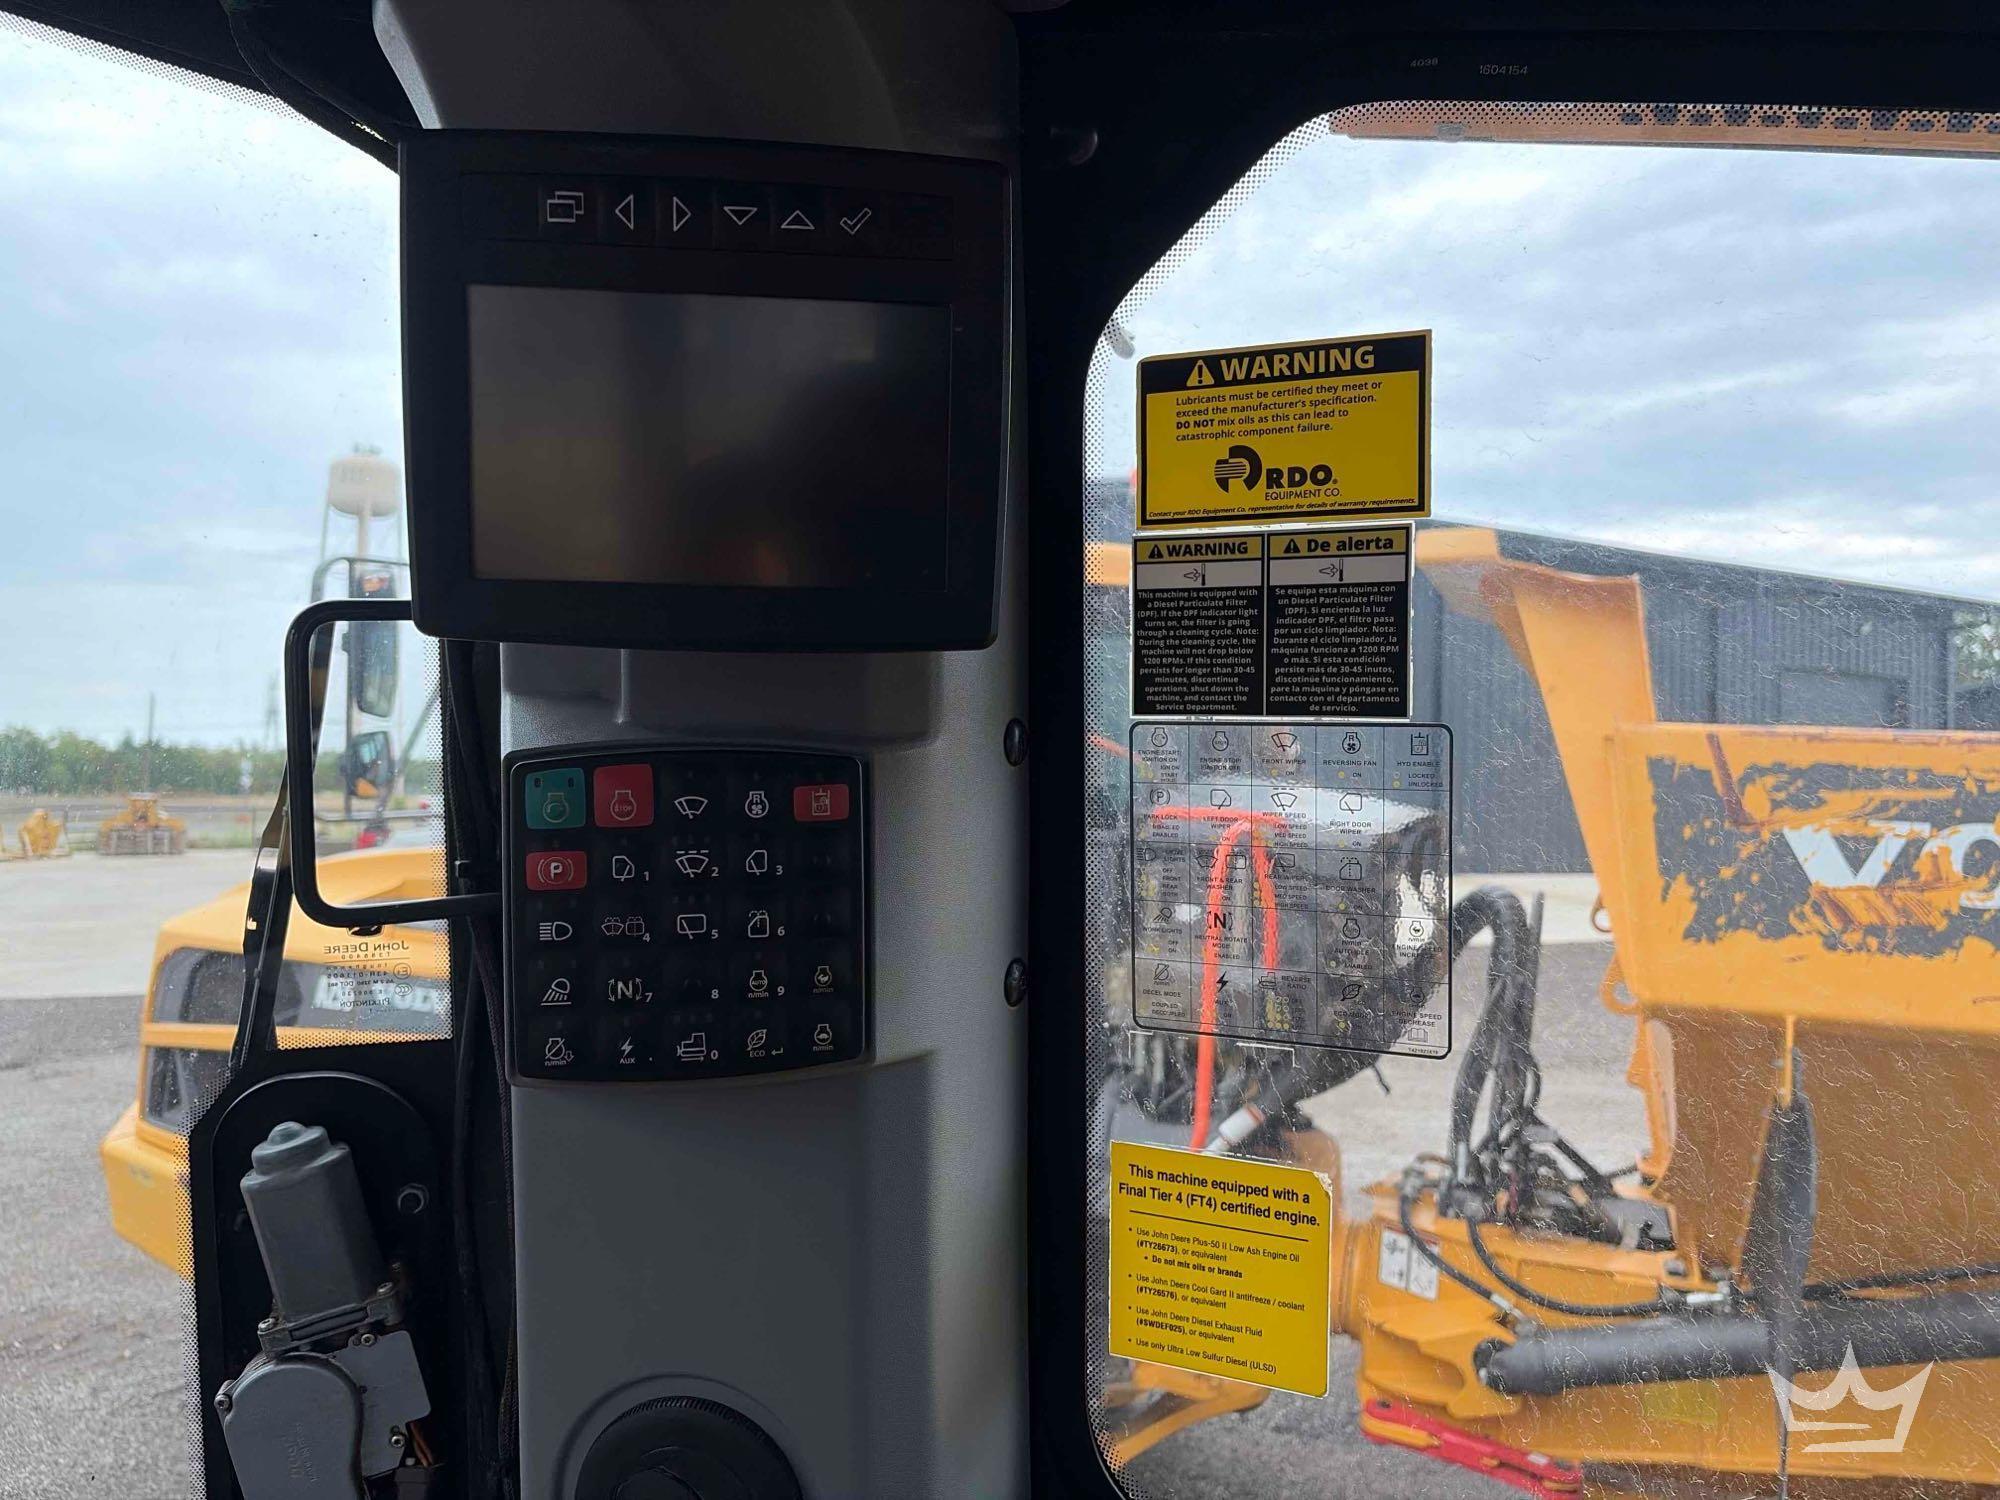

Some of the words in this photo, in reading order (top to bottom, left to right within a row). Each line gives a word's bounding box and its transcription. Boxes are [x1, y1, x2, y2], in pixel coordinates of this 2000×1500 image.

[1220, 344, 1374, 381] WARNING
[1176, 393, 1226, 405] Lubricants
[1228, 390, 1253, 401] must
[1256, 389, 1268, 399] be
[1271, 385, 1313, 398] certified
[1315, 383, 1338, 396] they
[1341, 381, 1368, 392] meet
[1176, 406, 1208, 417] exceed
[1211, 404, 1227, 414] the
[1230, 398, 1306, 413] manufacturer's
[1308, 392, 1376, 409] specification.
[1176, 420, 1190, 429] DO
[1193, 418, 1215, 428] NOT
[1217, 416, 1235, 426] mix
[1237, 415, 1254, 424] oils
[1271, 412, 1290, 422] this
[1313, 409, 1335, 419] lead
[1338, 408, 1348, 417] to
[1175, 428, 1235, 443] catastrophic
[1237, 424, 1294, 439] component
[1296, 421, 1332, 432] failure.
[1264, 488, 1321, 500] EQUIPMENT
[1323, 487, 1342, 497] CO.
[1201, 506, 1235, 515] Equipment
[1247, 504, 1294, 513] representative
[1337, 500, 1368, 508] warranty
[1368, 497, 1415, 507] requirements.
[1166, 541, 1248, 557] WARNING
[1306, 538, 1330, 552] De
[1335, 535, 1393, 551] alerta
[1155, 590, 1188, 598] machine
[1198, 589, 1236, 598] equipped
[1287, 587, 1316, 596] equipa
[1339, 585, 1378, 594] máquina
[550, 862, 562, 877] P
[644, 872, 649, 881] 1
[711, 867, 719, 877] 2
[776, 866, 783, 875] 3
[643, 933, 650, 942] 4
[711, 930, 718, 939] 5
[777, 927, 785, 936] 6
[618, 981, 632, 998] N
[645, 992, 652, 1002] 7
[711, 989, 719, 999] 8
[777, 986, 784, 996] 9
[545, 1058, 566, 1066] n/min
[711, 1050, 718, 1059] 0
[1128, 1163, 1153, 1179] This
[1157, 1168, 1208, 1188] machine
[1210, 1176, 1268, 1200] equipped
[1272, 1185, 1298, 1202] with
[1302, 1193, 1309, 1204] a
[1118, 1181, 1146, 1198] Final
[1149, 1186, 1172, 1202] Tier
[1175, 1190, 1182, 1204] 4
[1186, 1192, 1217, 1212] (FT4)
[1220, 1197, 1270, 1218] certified
[1274, 1206, 1320, 1229] engine.
[1136, 1227, 1150, 1236] Use
[1151, 1229, 1168, 1239] John
[1170, 1233, 1190, 1243] Deere
[1192, 1236, 1220, 1248] Plus-50
[1229, 1243, 1244, 1253] Low
[1246, 1246, 1260, 1255] Ash
[1262, 1248, 1287, 1262] Engine
[1289, 1253, 1299, 1262] Oil
[1190, 1248, 1226, 1264] equivalent
[1152, 1255, 1162, 1264] Do
[1163, 1257, 1175, 1266] not
[1176, 1259, 1190, 1269] mix
[1192, 1262, 1205, 1272] oils
[1217, 1266, 1242, 1278] brands
[1136, 1273, 1149, 1282] Use
[1150, 1276, 1168, 1286] John
[1170, 1279, 1190, 1290] Deere
[1191, 1283, 1207, 1293] Cool
[1209, 1286, 1226, 1297] Gard
[1236, 1291, 1271, 1305] antifreeze
[1277, 1299, 1305, 1311] coolant
[1190, 1295, 1226, 1311] equivalent
[1136, 1305, 1149, 1314] Use
[1150, 1308, 1168, 1318] John
[1169, 1312, 1189, 1322] Deere
[1191, 1316, 1213, 1327] Diesel
[1214, 1320, 1243, 1333] Exhaust
[1244, 1326, 1262, 1337] Fluid
[1198, 1329, 1234, 1345] equivalent
[1135, 1337, 1148, 1347] Use
[1150, 1340, 1165, 1352] only
[1167, 1344, 1184, 1354] Ultra
[1185, 1347, 1200, 1357] Low
[1202, 1351, 1223, 1362] Sulfur
[1225, 1356, 1247, 1367] Diesel
[1249, 1360, 1276, 1375] (ULSD)
